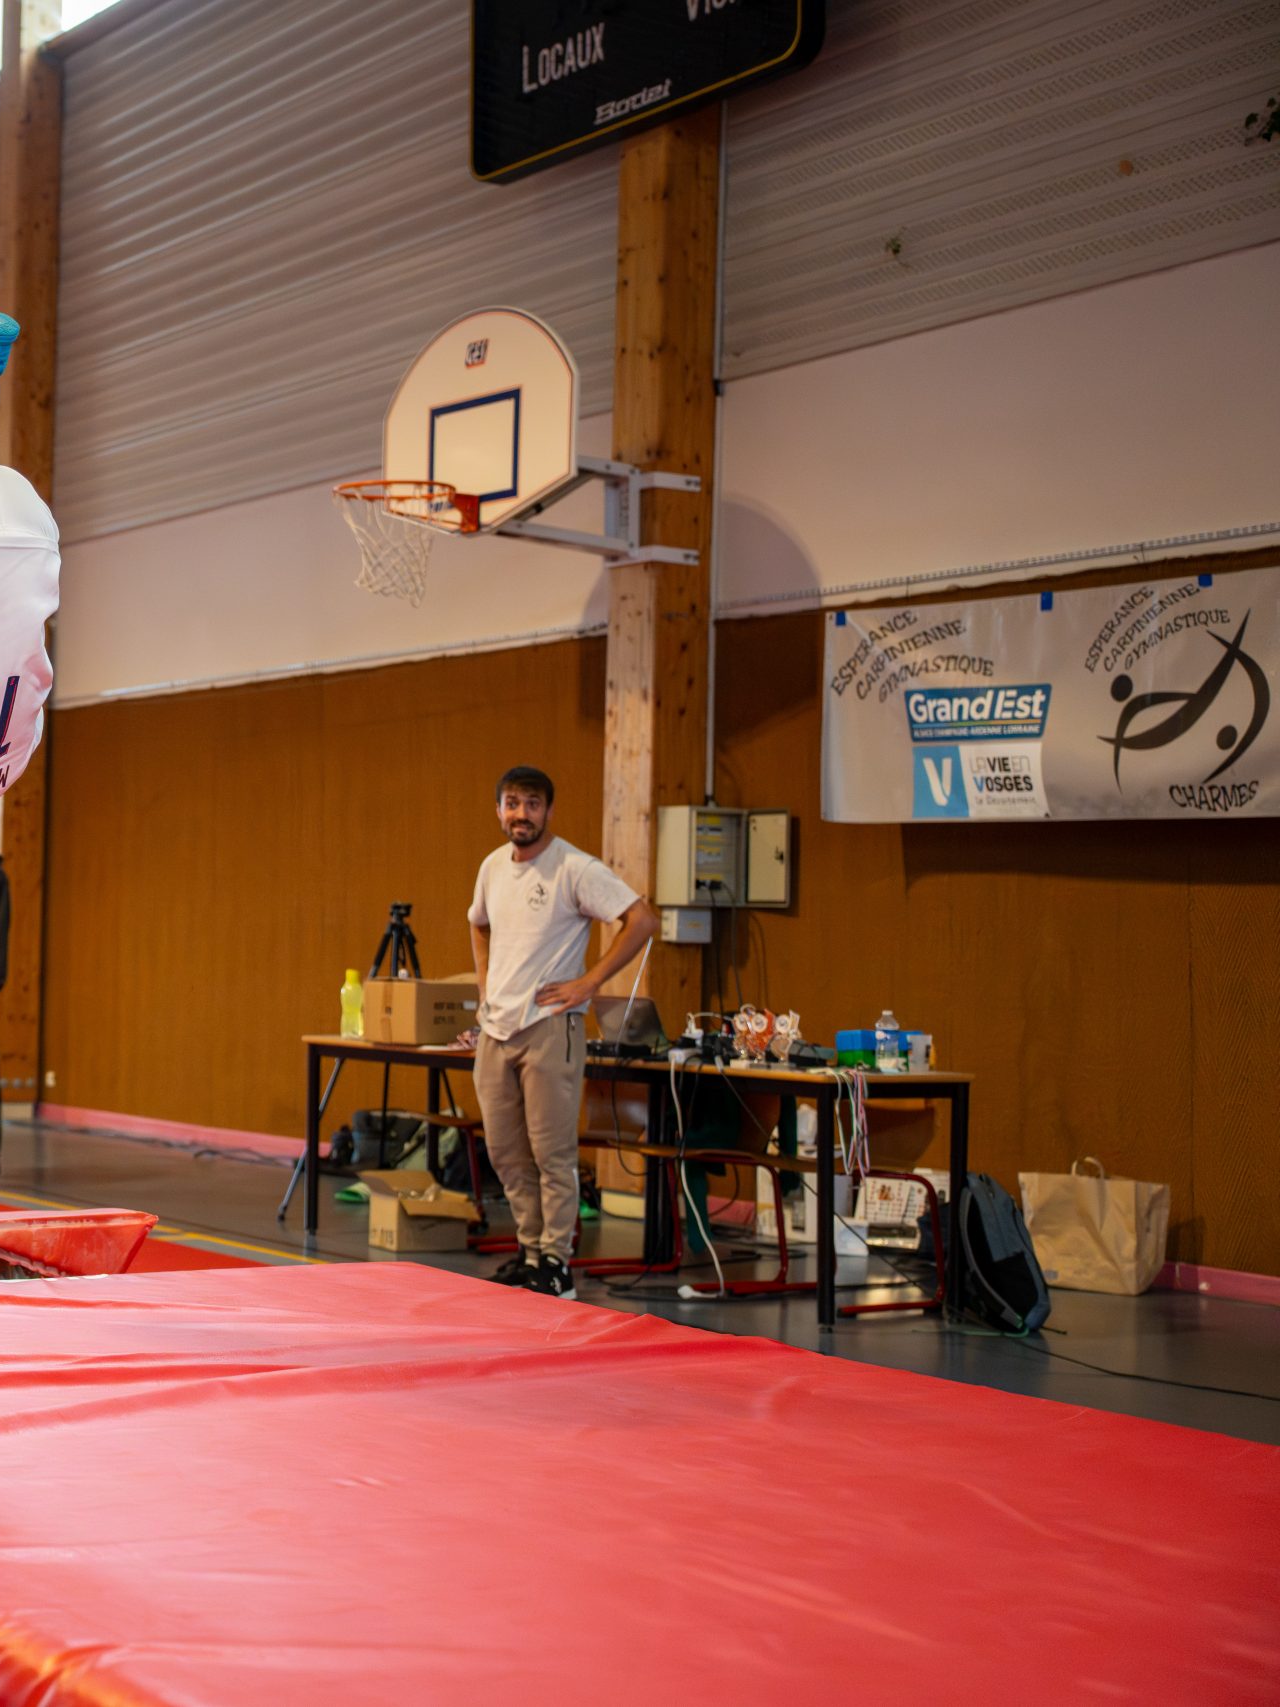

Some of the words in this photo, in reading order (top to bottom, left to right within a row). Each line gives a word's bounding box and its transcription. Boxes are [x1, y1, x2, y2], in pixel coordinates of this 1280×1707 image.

[522, 22, 605, 94] LOCAUX
[830, 610, 918, 696] ESPERANCE
[1085, 585, 1155, 674] ESPERANCE
[1103, 583, 1200, 672] CARPINIENNE
[1125, 608, 1231, 670] GYMNASTIQUE
[879, 654, 995, 703] GYMNASTIQUE
[973, 775, 1034, 794] VOSGES
[1169, 780, 1260, 813] CHARMES
